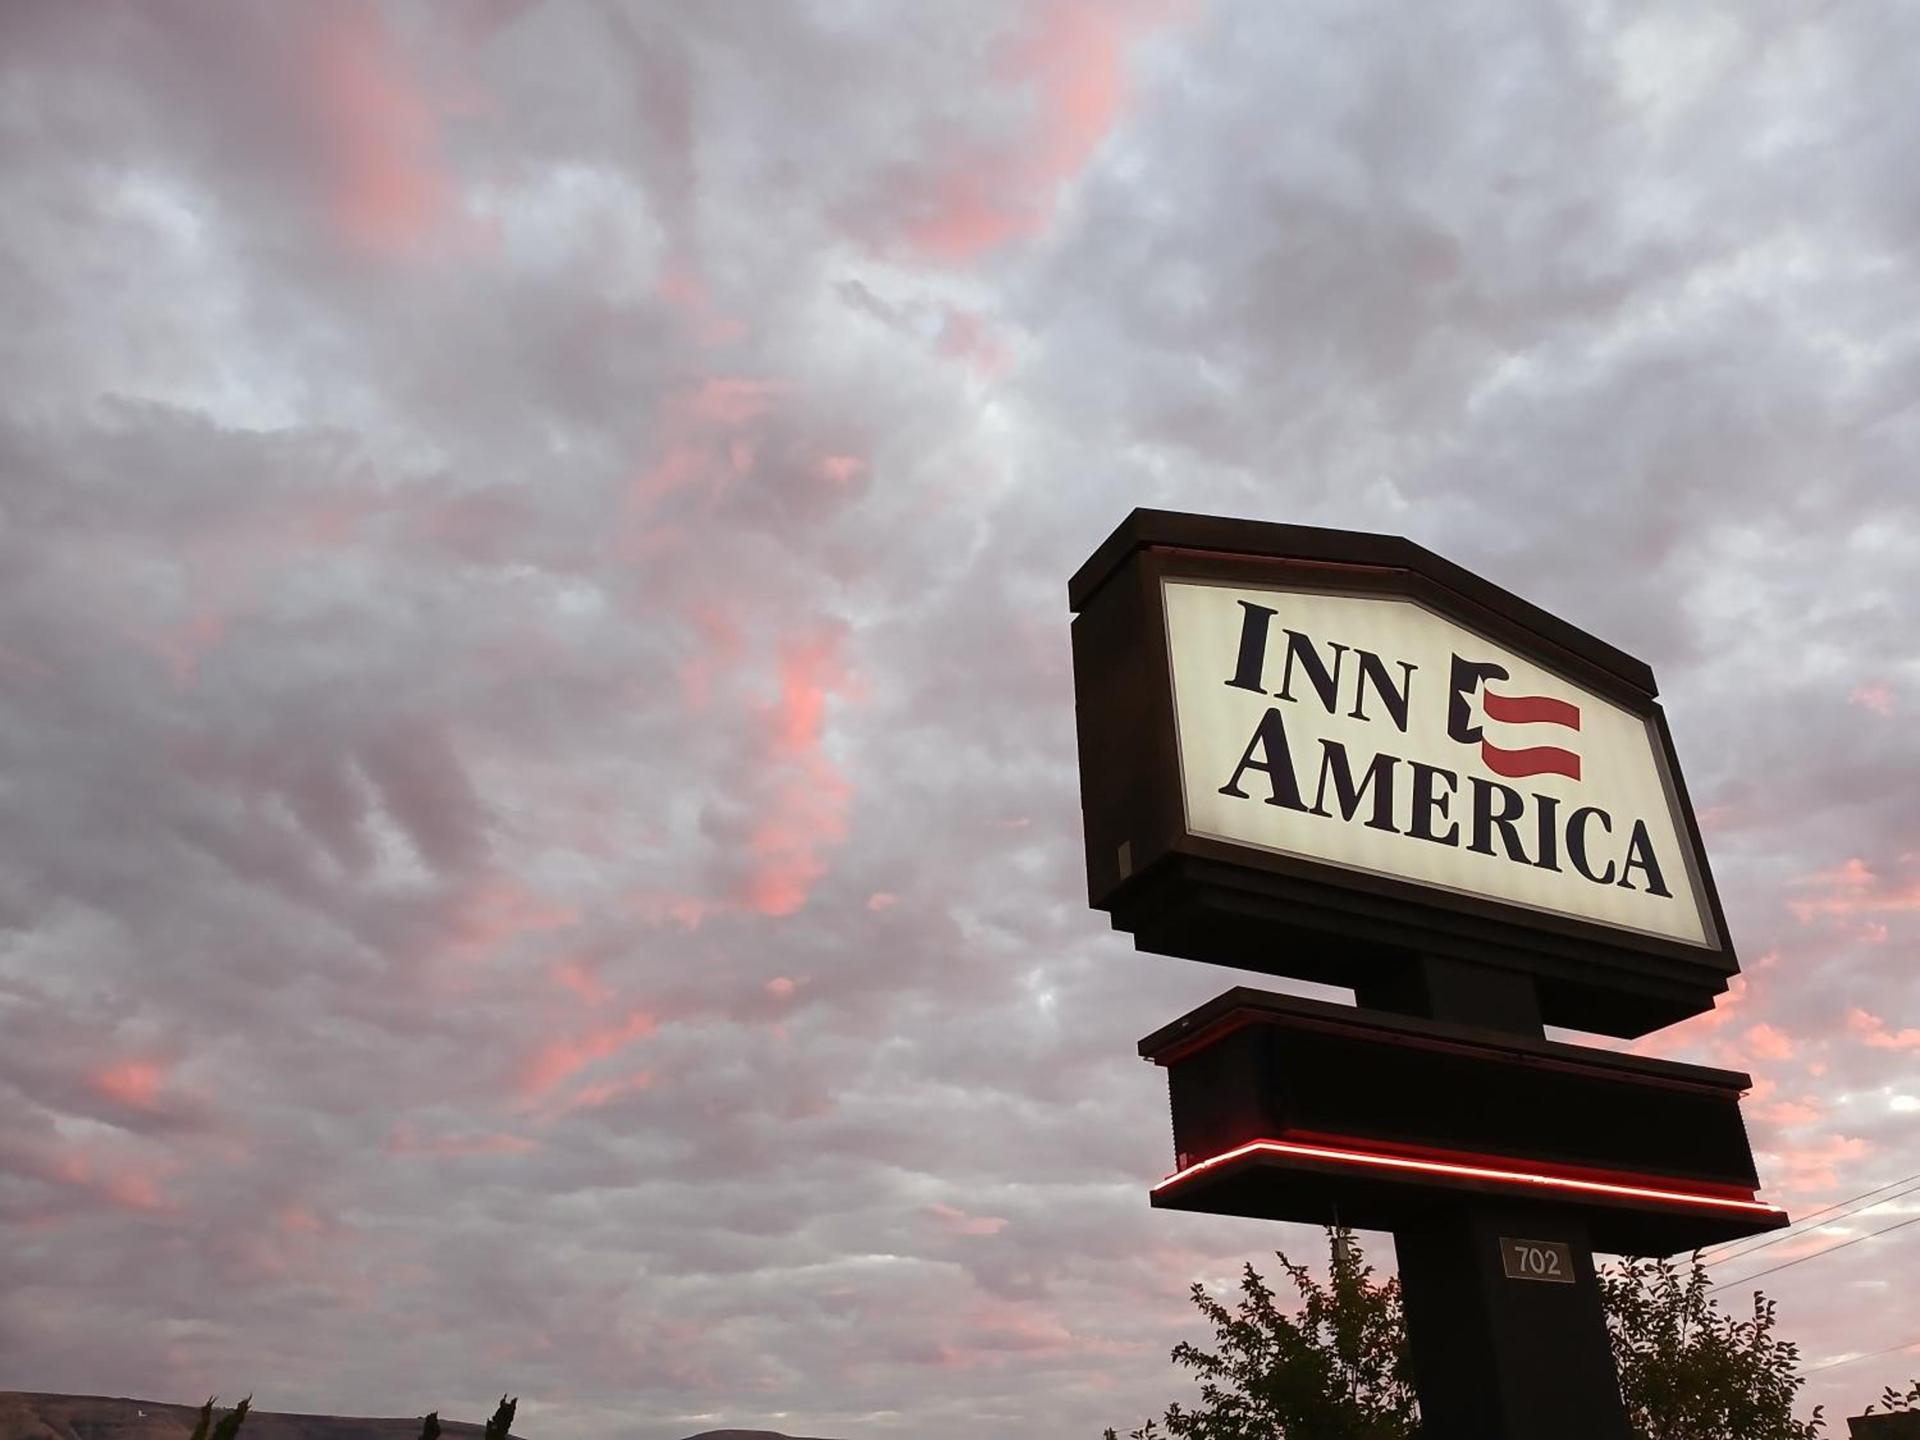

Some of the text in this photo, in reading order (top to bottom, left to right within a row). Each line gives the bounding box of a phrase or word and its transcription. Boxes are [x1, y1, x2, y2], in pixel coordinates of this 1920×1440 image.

[1223, 599, 1419, 733] INN
[1217, 707, 1674, 899] AMERICA
[1514, 1246, 1561, 1275] 702
